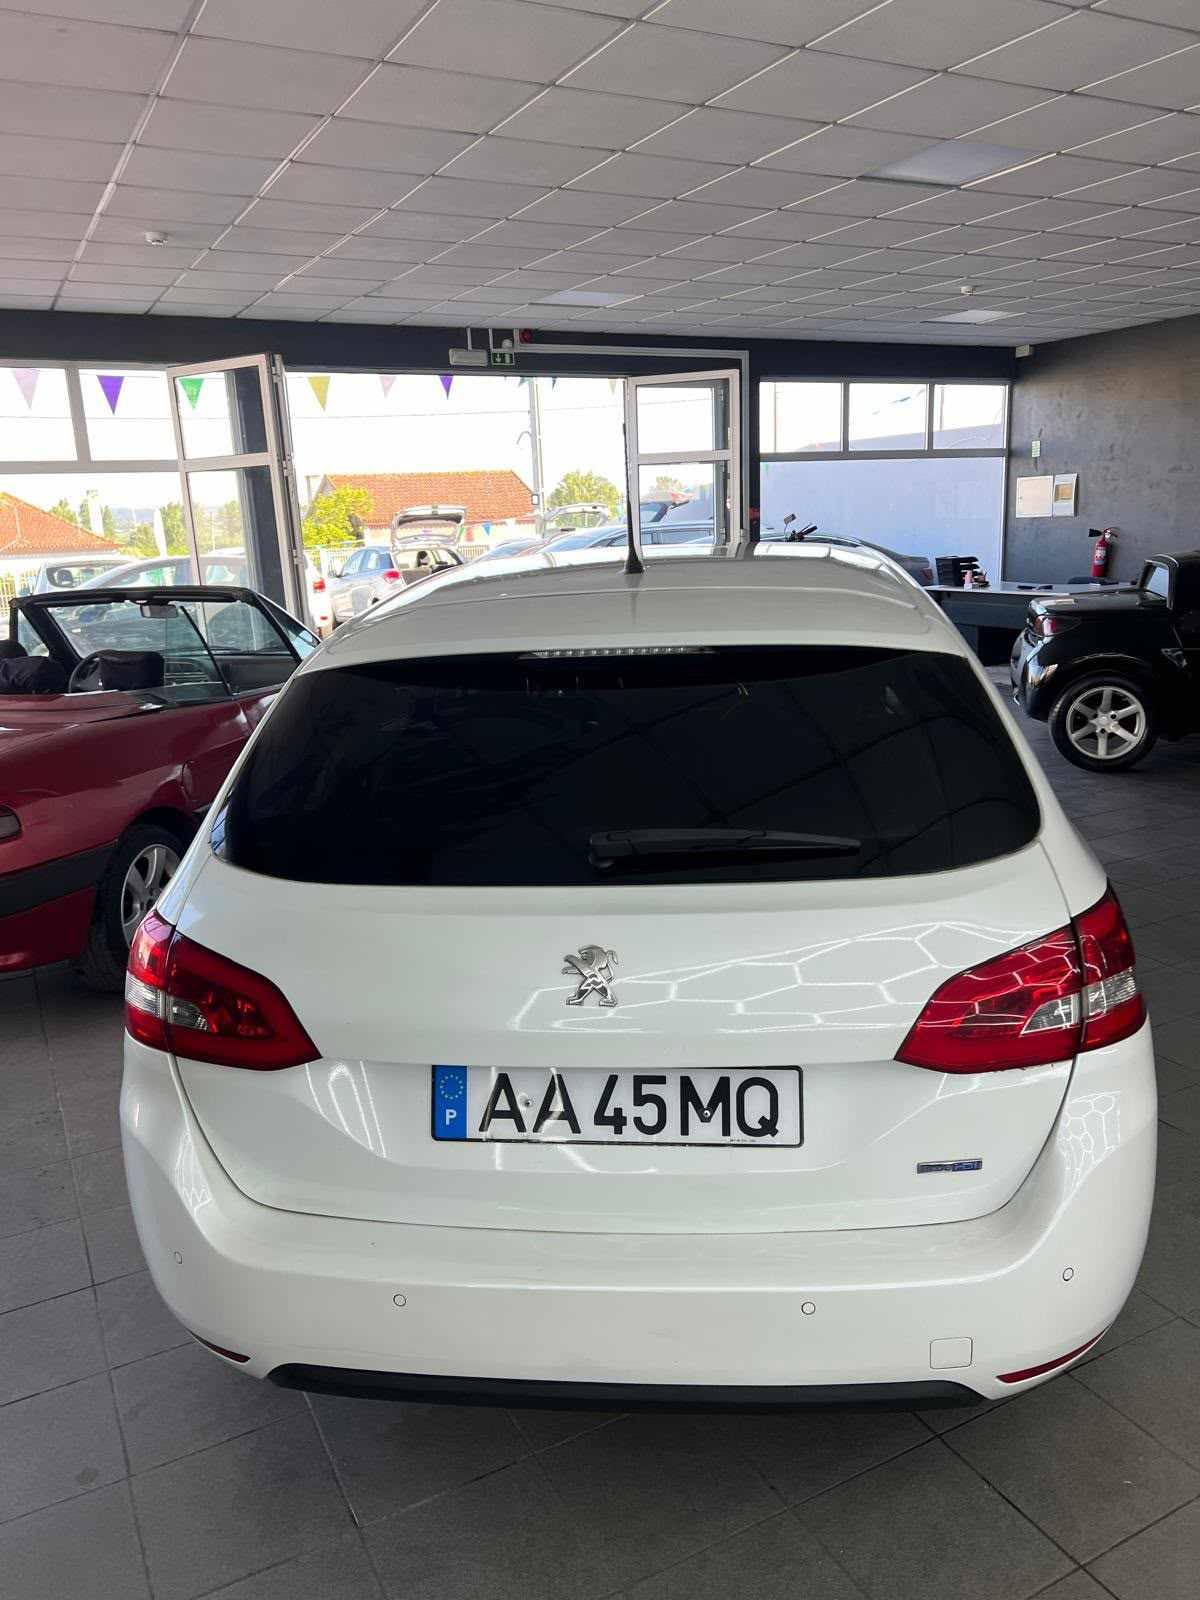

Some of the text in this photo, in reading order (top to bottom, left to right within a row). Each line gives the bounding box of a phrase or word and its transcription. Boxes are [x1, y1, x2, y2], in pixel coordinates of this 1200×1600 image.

[445, 1109, 457, 1125] P
[479, 1073, 779, 1137] AA 45 MQ
